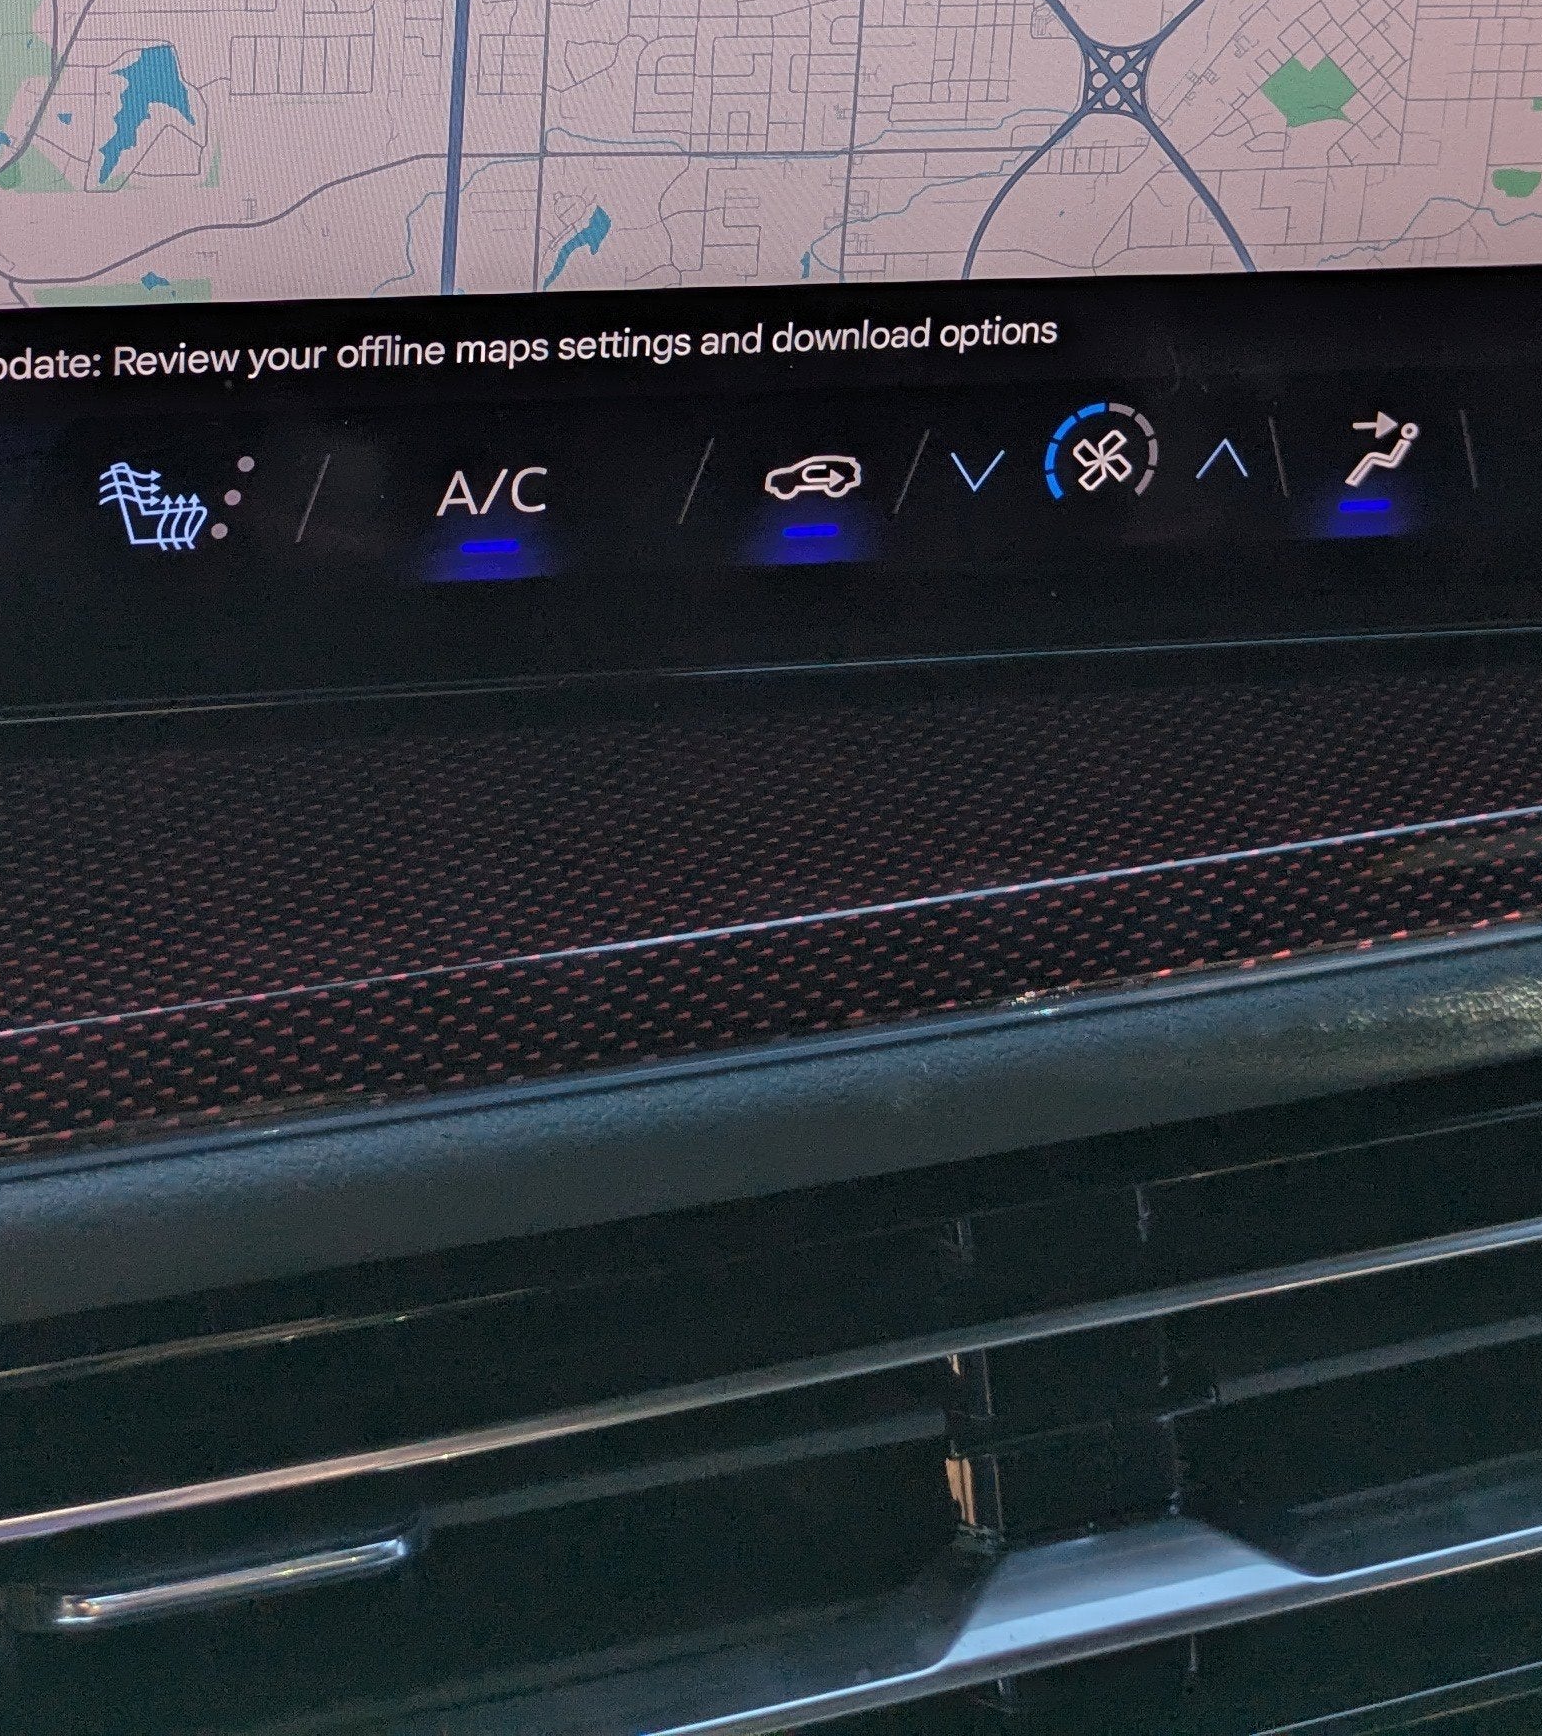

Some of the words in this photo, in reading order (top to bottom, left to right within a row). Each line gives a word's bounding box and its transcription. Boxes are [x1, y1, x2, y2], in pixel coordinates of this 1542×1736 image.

[113, 341, 241, 377] Review
[246, 344, 329, 381] your
[335, 333, 447, 370] offline
[455, 337, 550, 371] maps
[557, 325, 693, 366] settings
[699, 321, 764, 357] and
[770, 316, 932, 354] download
[938, 314, 1059, 355] options
[435, 465, 549, 518] A/C
